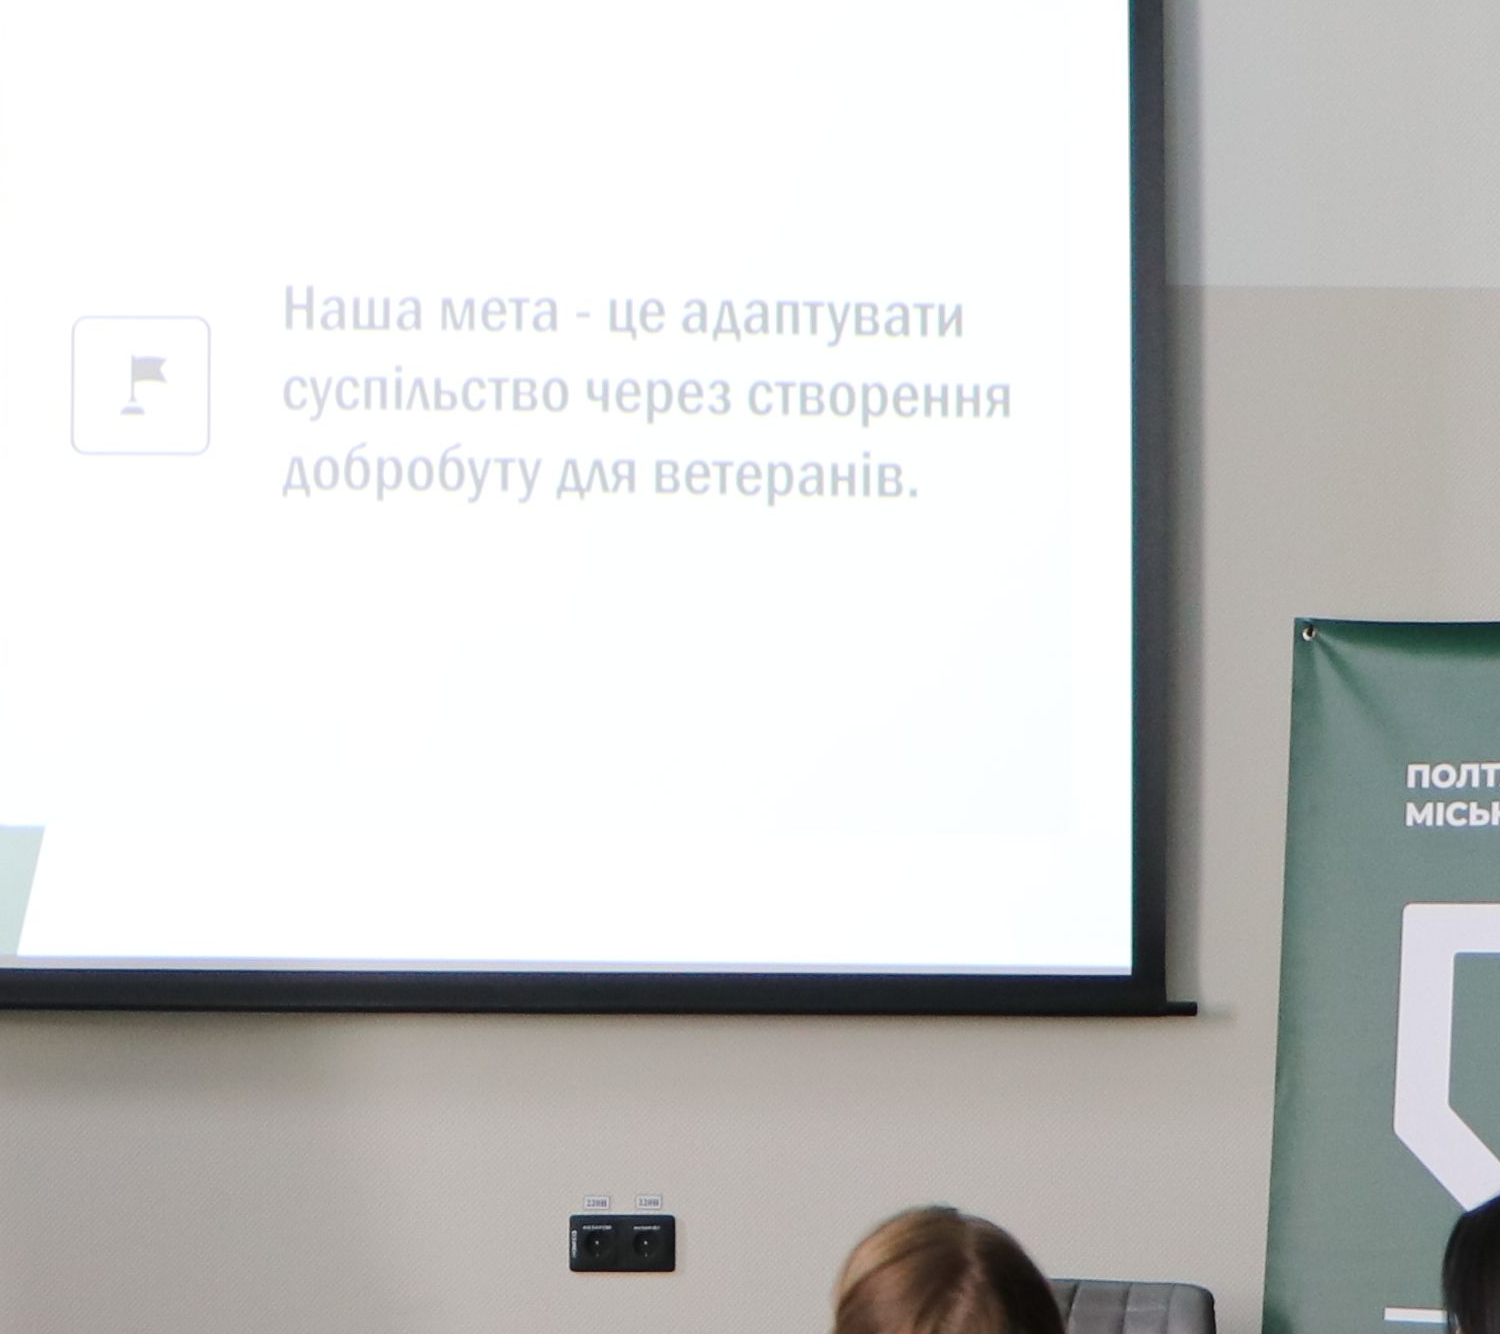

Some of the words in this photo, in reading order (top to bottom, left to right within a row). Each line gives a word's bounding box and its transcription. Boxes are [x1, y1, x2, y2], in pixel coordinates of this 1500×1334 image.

[283, 285, 424, 337] Наша
[440, 292, 560, 337] мета
[608, 296, 666, 343] це
[681, 294, 965, 350] адаптувати
[283, 366, 570, 424] суспільство
[585, 376, 732, 424] через
[748, 376, 1012, 425] створення
[283, 442, 542, 504] добробуту
[556, 457, 637, 504] для
[653, 453, 919, 507] ветеранів.
